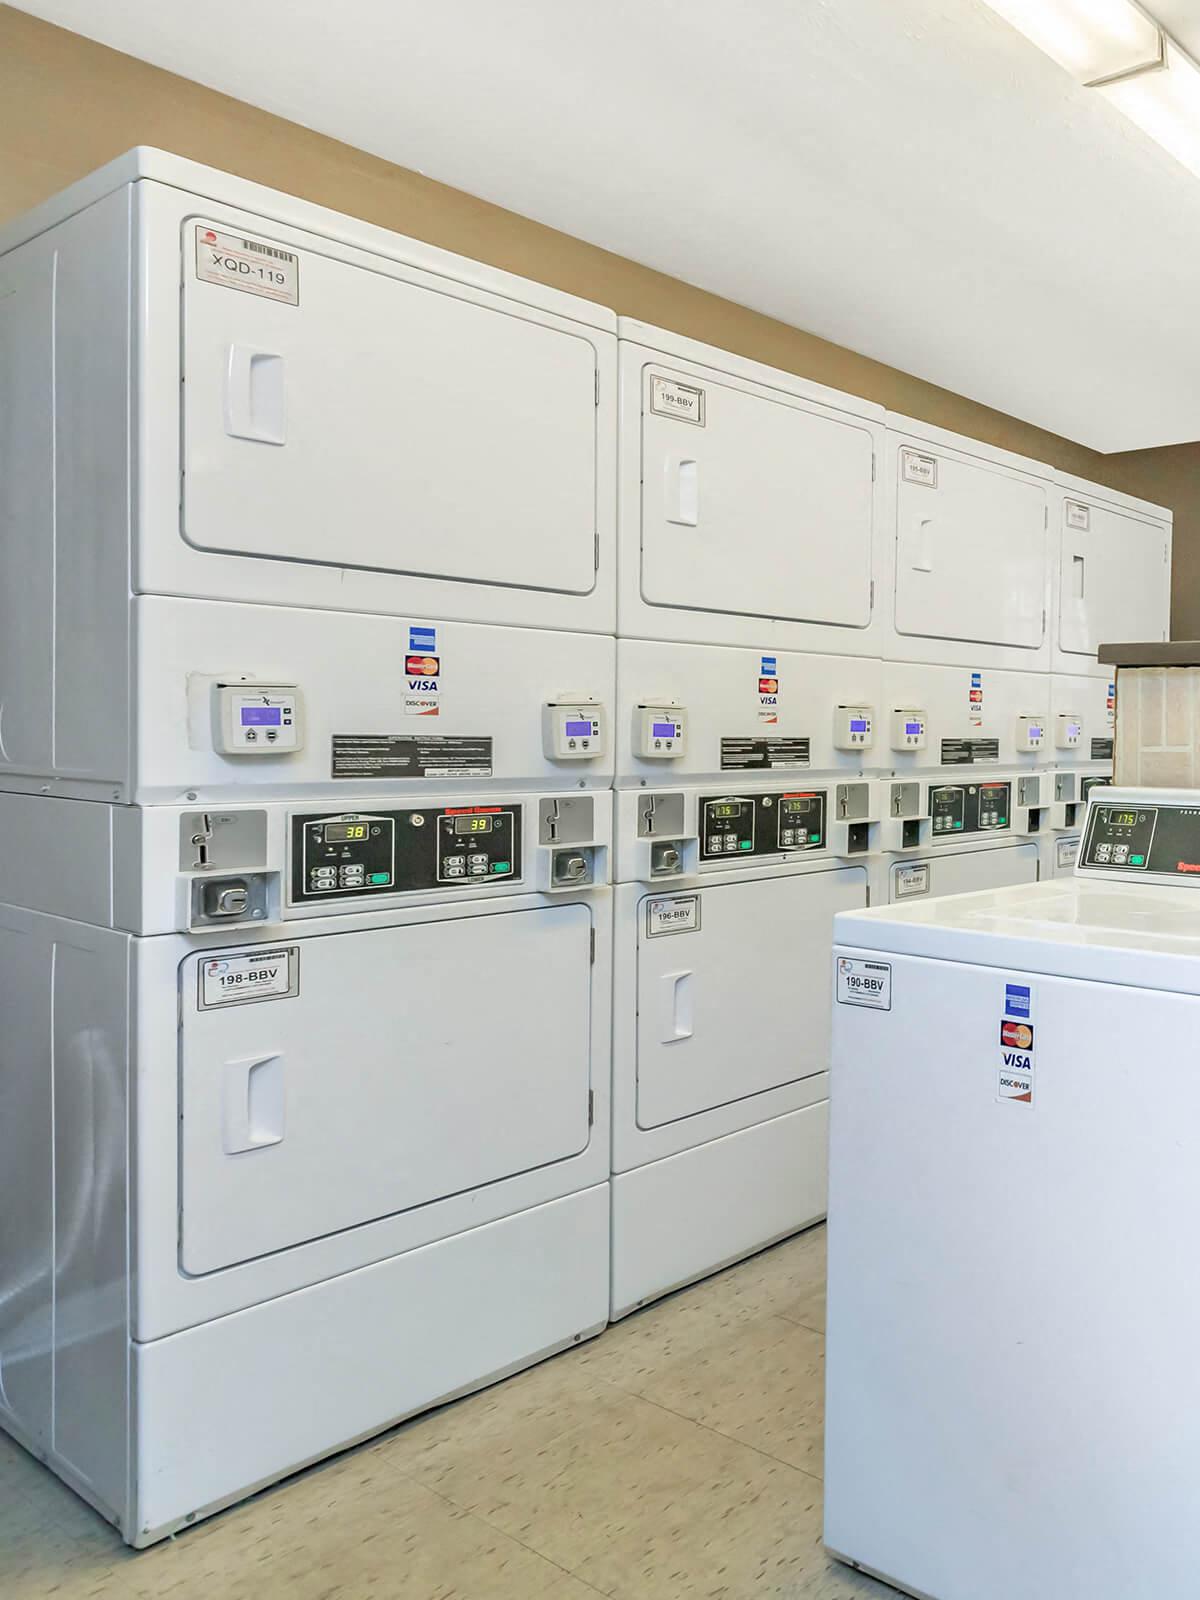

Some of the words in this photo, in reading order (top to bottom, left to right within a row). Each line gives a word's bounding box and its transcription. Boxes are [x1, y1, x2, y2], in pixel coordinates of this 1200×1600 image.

[212, 253, 285, 285] XQD-119
[408, 680, 438, 691] VISA
[760, 696, 777, 704] VISA
[471, 819, 487, 831] 39
[346, 826, 364, 839] 38
[220, 968, 278, 985] 198-BBV
[846, 976, 884, 991] 190-BBV
[1002, 1052, 1031, 1070] VISA
[1000, 1078, 1030, 1090] DISCOVER
